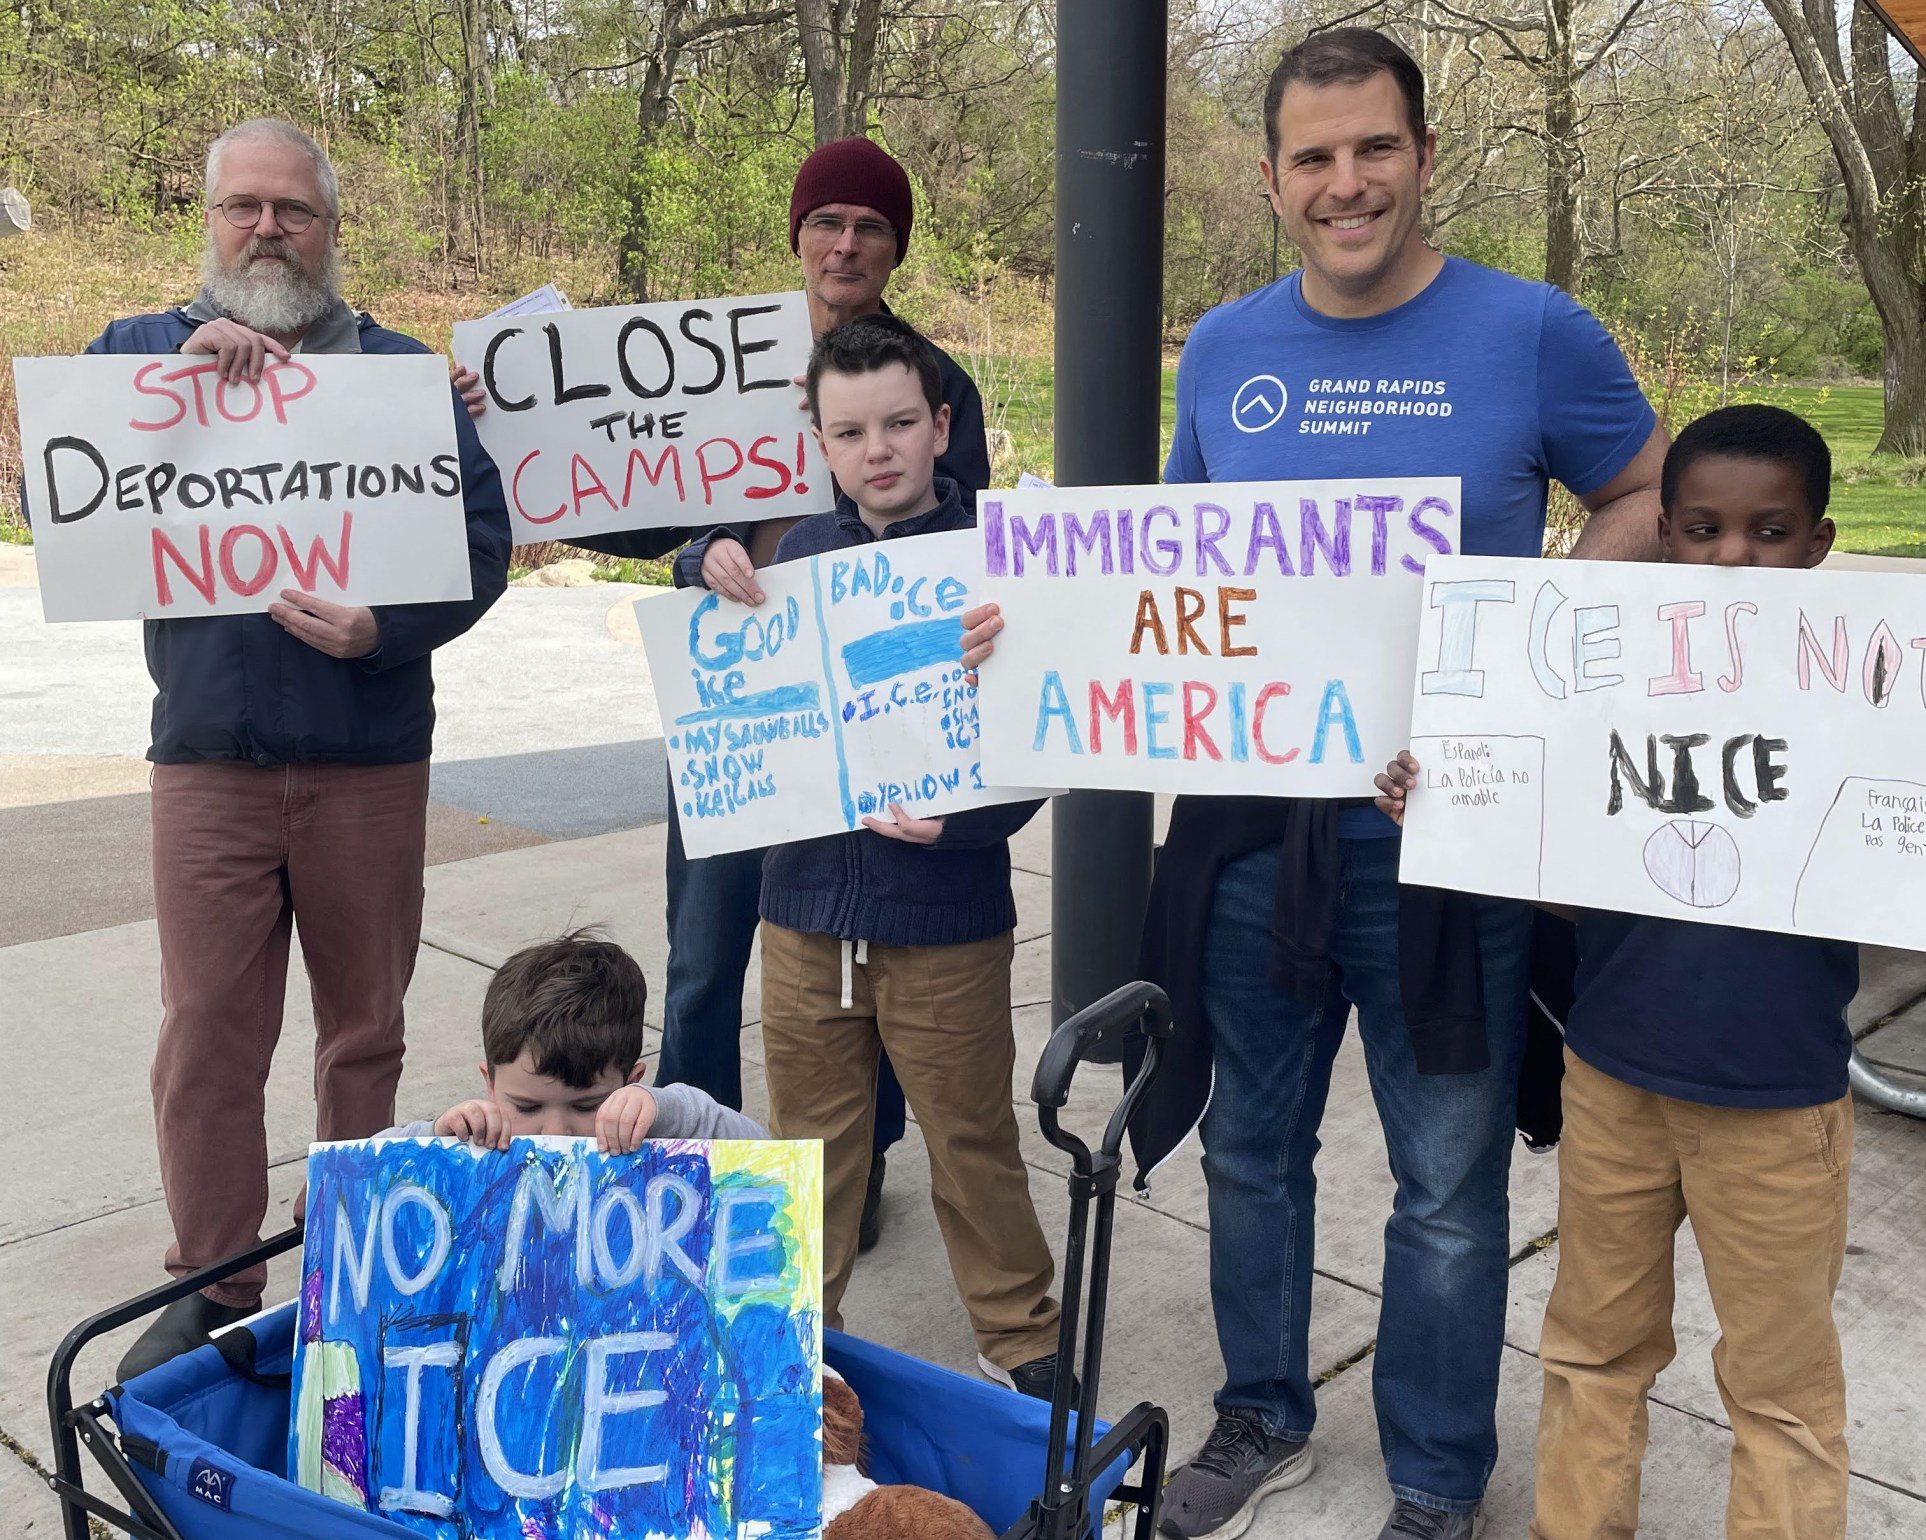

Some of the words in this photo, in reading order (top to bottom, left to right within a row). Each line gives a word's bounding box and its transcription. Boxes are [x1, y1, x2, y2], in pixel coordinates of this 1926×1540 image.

[483, 304, 791, 412] CLOSE
[1308, 379, 1370, 394] GRAND
[1376, 379, 1446, 395] RAPIDS
[129, 362, 316, 431] STOP
[590, 411, 687, 442] THE
[1299, 420, 1371, 435] SUMMIT
[1304, 400, 1452, 417] NEIGHBORHOOD
[44, 437, 460, 524] DEPORTATIONS
[512, 432, 809, 524] CAMPS!
[152, 511, 352, 606] NOW
[984, 494, 1454, 577] IMMIGRANTS
[831, 551, 891, 606] BAD
[1129, 586, 1258, 657] ARE
[1421, 579, 1624, 700] ICE
[1647, 601, 1759, 697] IS
[685, 719, 721, 755] MY
[1032, 670, 1365, 764] AMERICA
[687, 748, 763, 790] SNOW
[1427, 768, 1453, 788] La
[1512, 769, 1529, 784] no
[1451, 788, 1501, 806] amable
[1605, 728, 1790, 818] NICE
[1862, 812, 1883, 831] La
[327, 1185, 453, 1325] NO
[499, 1157, 783, 1294] MORE
[379, 1331, 679, 1517] ICE
[195, 1485, 222, 1504] MAC
